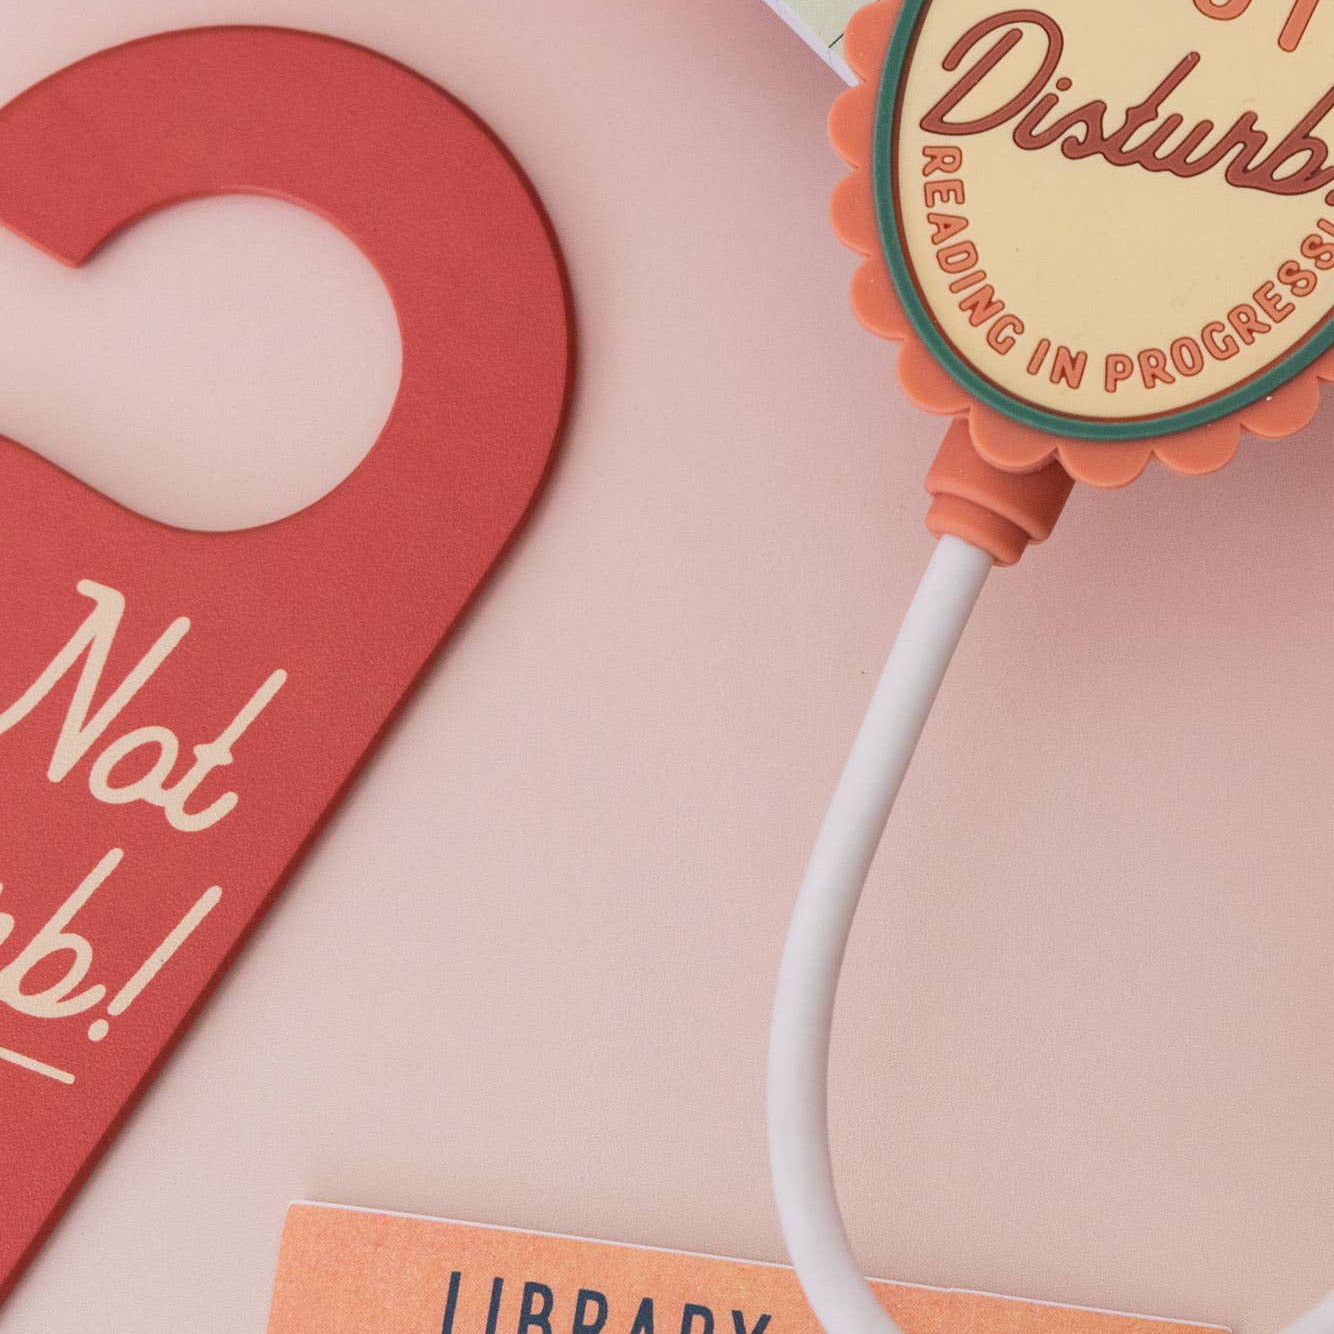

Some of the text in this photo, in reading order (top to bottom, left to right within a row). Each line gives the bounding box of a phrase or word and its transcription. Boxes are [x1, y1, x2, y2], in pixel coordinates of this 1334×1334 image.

[921, 143, 1027, 357] READING
[1026, 337, 1088, 391] IN
[0, 578, 288, 832] Not
